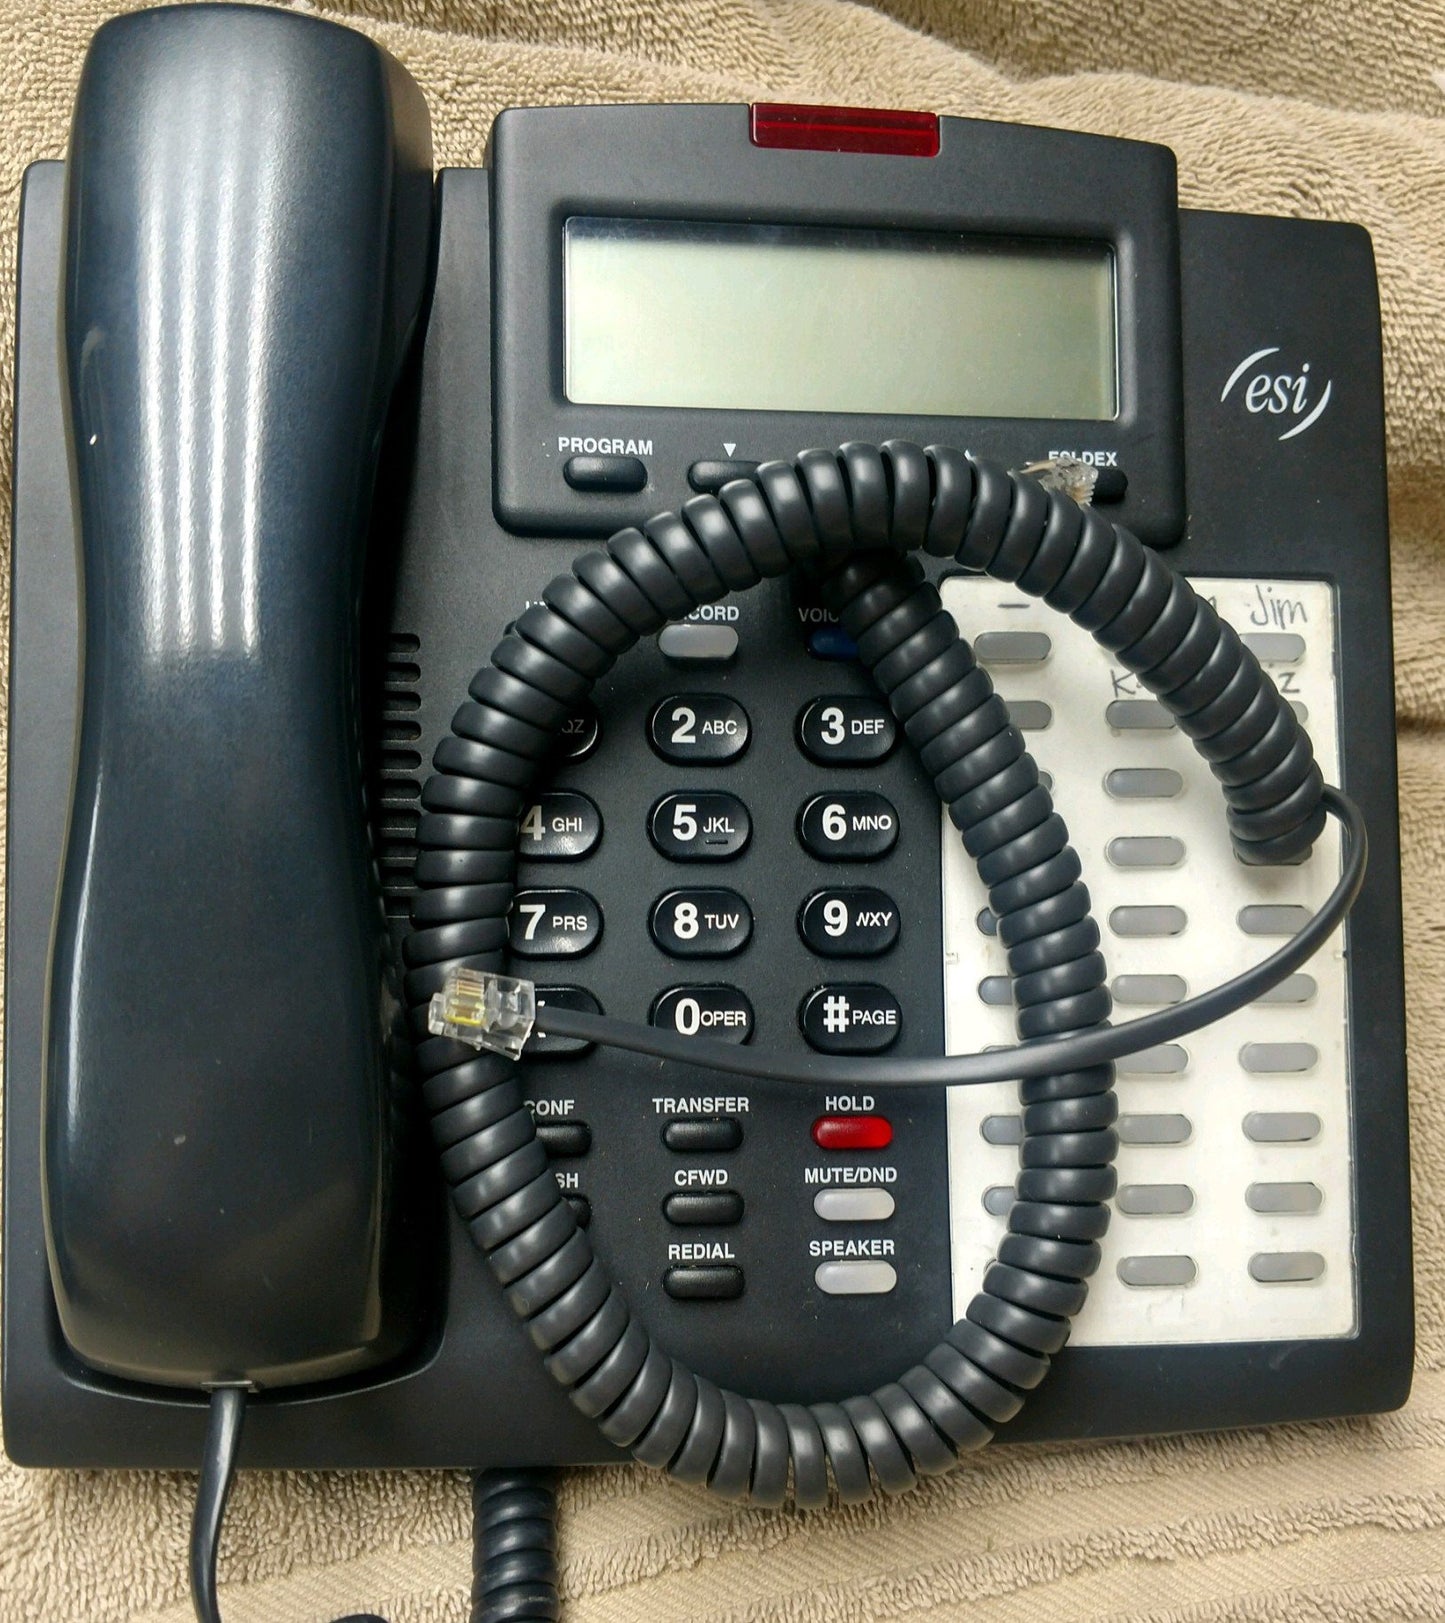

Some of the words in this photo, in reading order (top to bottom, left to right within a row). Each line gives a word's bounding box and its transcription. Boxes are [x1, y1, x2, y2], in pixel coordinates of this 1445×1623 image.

[1245, 362, 1310, 414] esi
[558, 437, 653, 455] PROGRAM
[684, 605, 740, 621] CORD
[798, 607, 839, 623] VOIC
[1250, 584, 1308, 630] Jim
[671, 707, 696, 743] 2
[702, 720, 737, 735] ABC
[821, 707, 845, 745] 3
[851, 719, 885, 734] DEF
[520, 805, 546, 841] 4
[552, 817, 582, 832] GHI
[672, 804, 697, 841] 5
[703, 817, 735, 833] JKL
[822, 804, 847, 840] 6
[852, 815, 892, 831] MNO
[519, 904, 546, 940] 7
[553, 916, 588, 931] PRS
[673, 902, 699, 939] 8
[704, 914, 739, 929] TUV
[823, 900, 848, 937] 9
[675, 998, 700, 1035] 0
[700, 1011, 747, 1026] OPER
[823, 996, 849, 1033] #
[852, 1010, 896, 1025] PAGE
[652, 1097, 749, 1113] TRANSFER
[825, 1096, 875, 1111] HOLD
[674, 1169, 728, 1186] CFWD
[804, 1167, 897, 1183] MUTE/DND
[668, 1243, 735, 1260] REDIAL
[809, 1240, 895, 1256] SPEAKER
